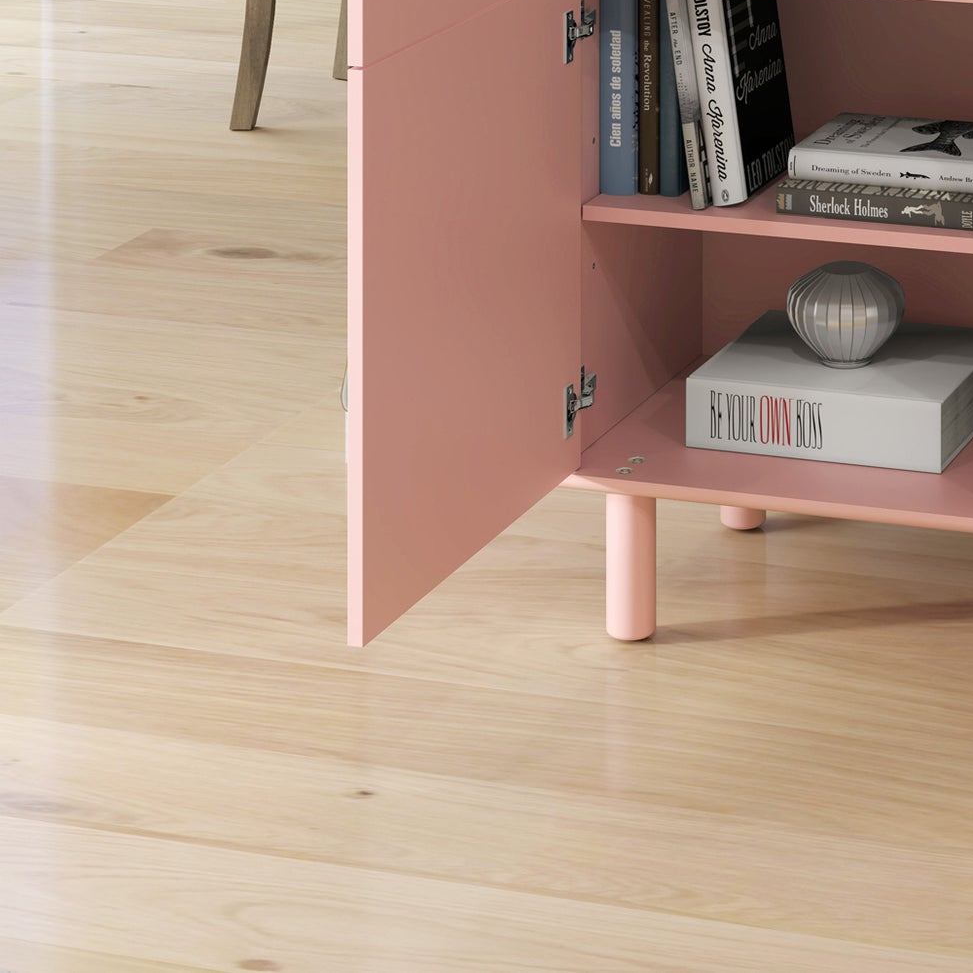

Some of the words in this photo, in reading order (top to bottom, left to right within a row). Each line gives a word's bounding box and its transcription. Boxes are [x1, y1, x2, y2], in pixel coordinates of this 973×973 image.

[670, 12, 678, 35] AFTER
[748, 21, 778, 51] Anna
[609, 30, 622, 73] soledad
[609, 76, 622, 90] de
[643, 54, 652, 111] Revolution
[701, 43, 716, 94] Anna
[735, 58, 783, 105] Karenina
[609, 93, 622, 120] años
[609, 122, 622, 148] Cien
[708, 99, 729, 182] Karenina
[686, 139, 695, 168] AUTHOR
[690, 172, 699, 193] NAME
[746, 161, 763, 193] LEO
[811, 165, 850, 175] Dreaming
[860, 168, 892, 177] Sweden
[938, 175, 964, 183] Andrew
[809, 194, 850, 215] Sherlock
[854, 199, 889, 219] Holmes
[710, 390, 722, 440] BE
[725, 393, 757, 443] YOUR
[759, 395, 794, 447] OWN
[796, 399, 823, 449] BOSS
